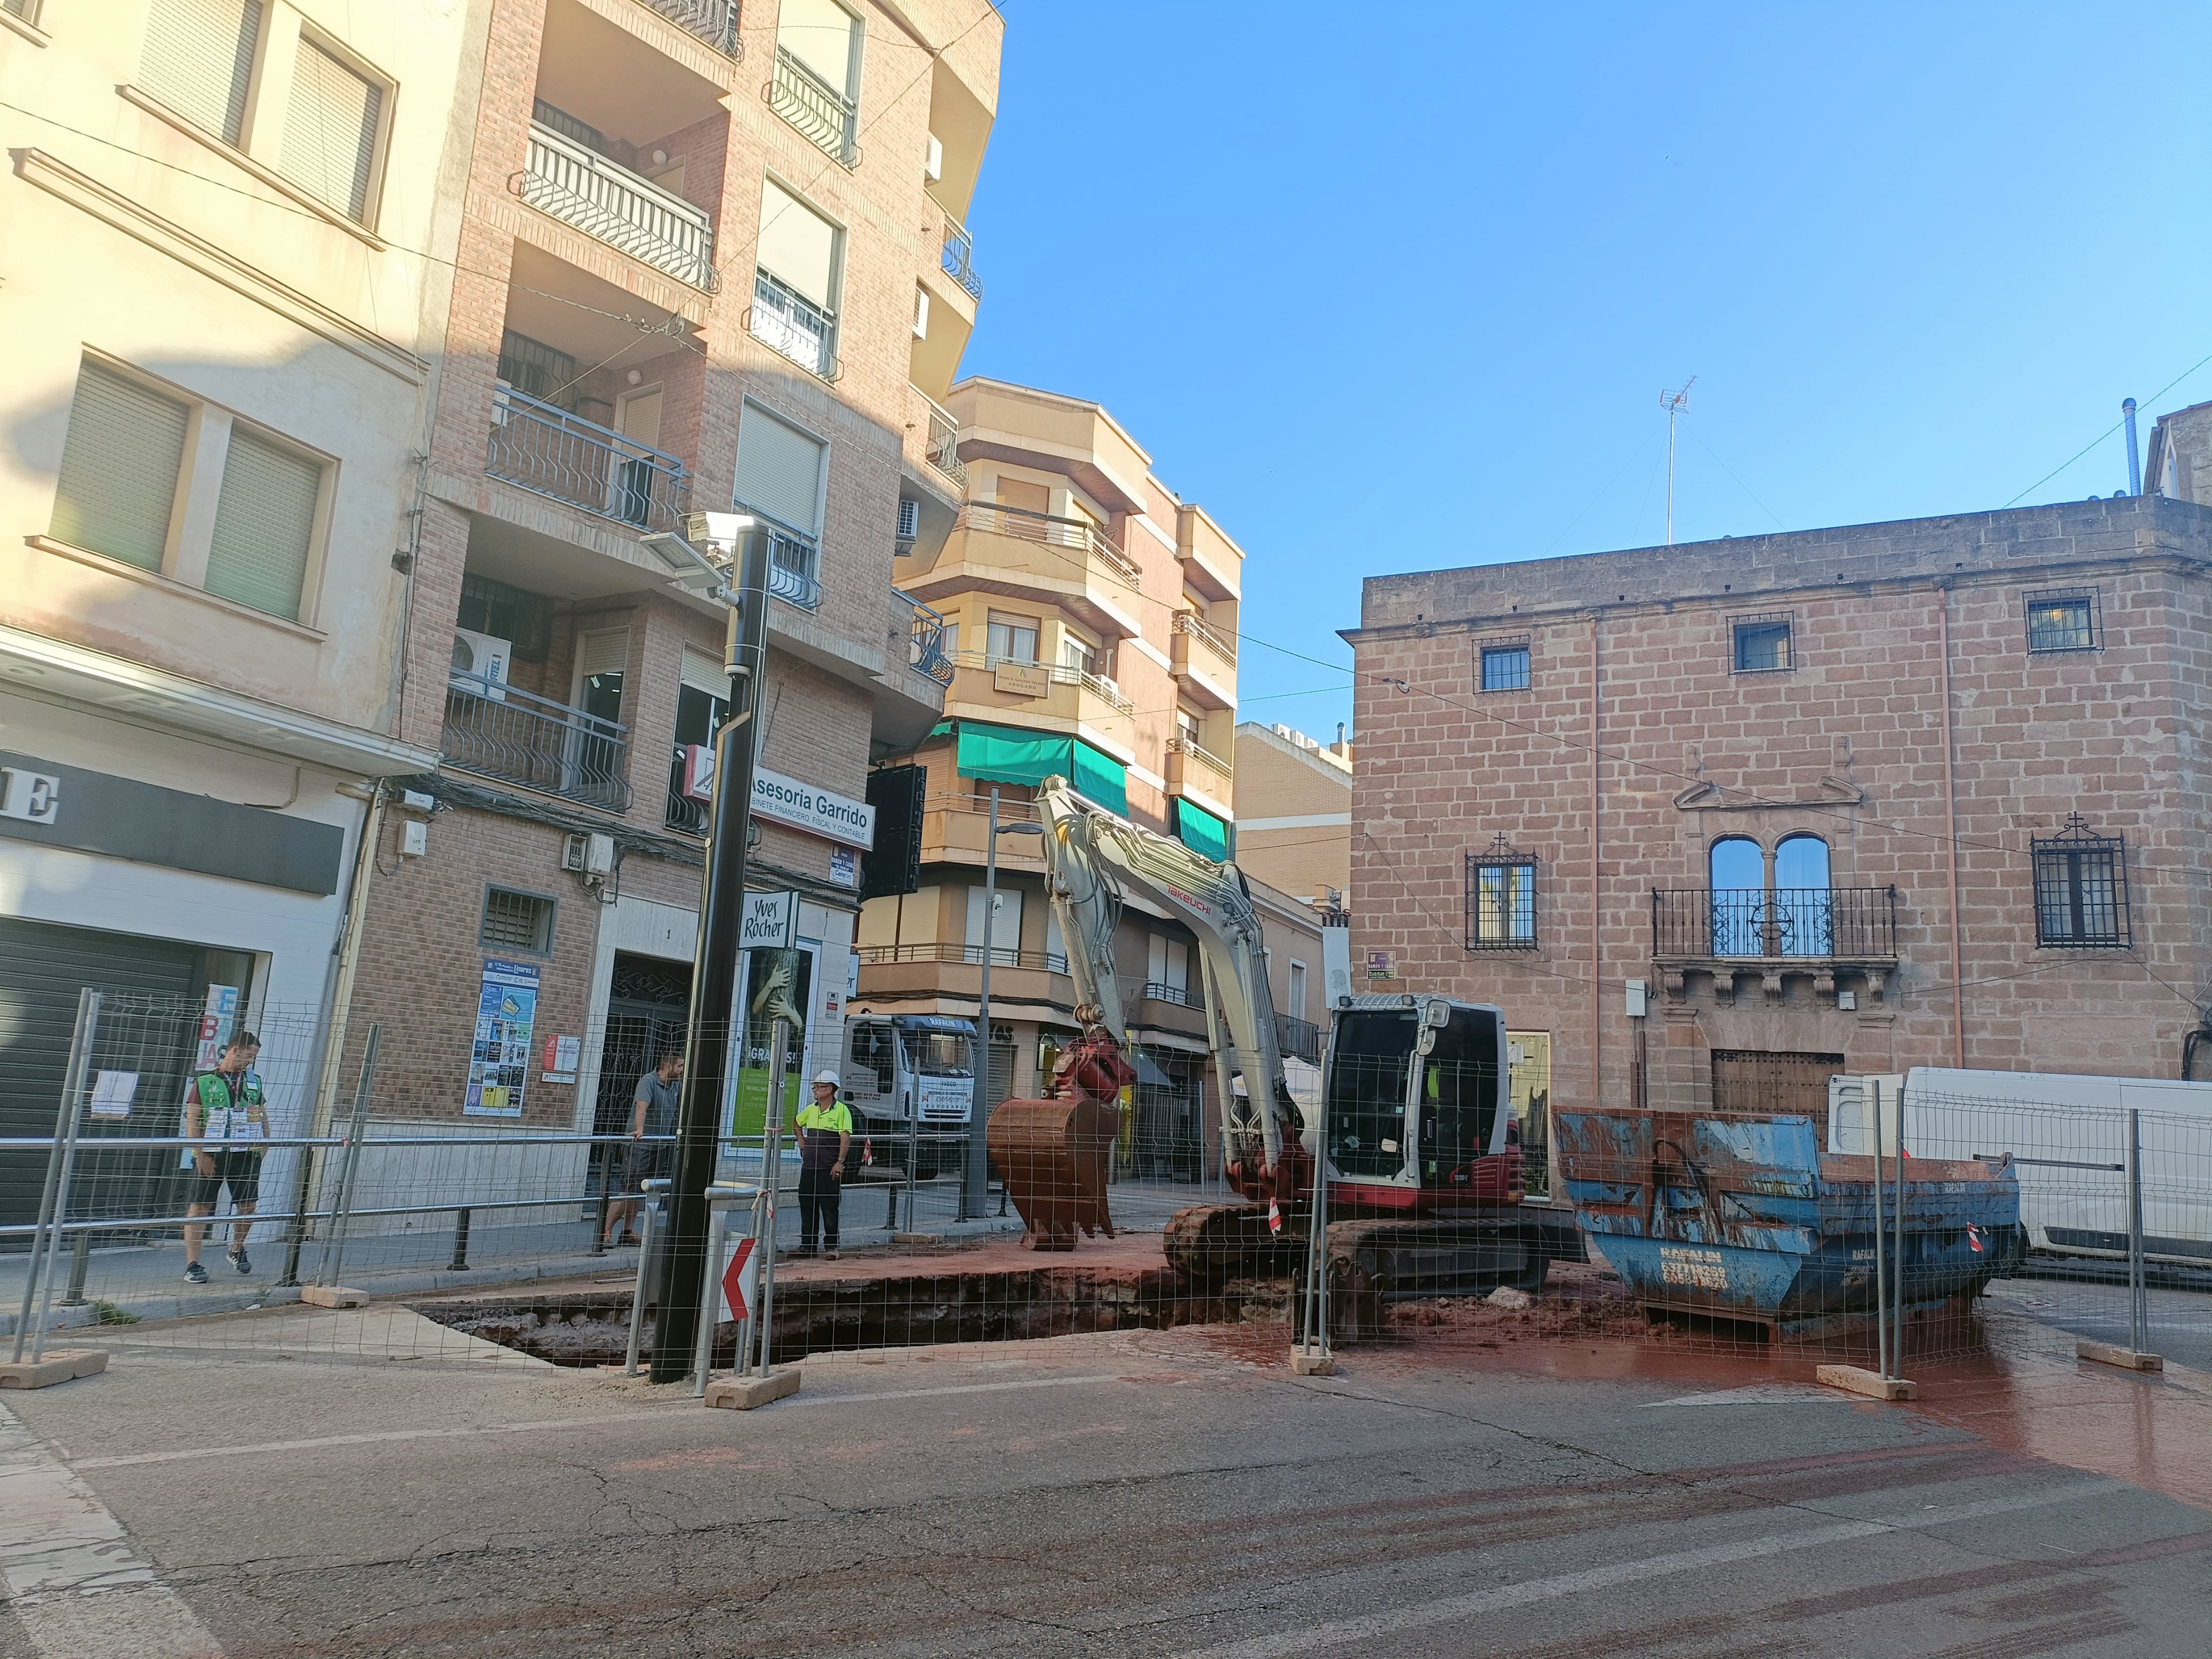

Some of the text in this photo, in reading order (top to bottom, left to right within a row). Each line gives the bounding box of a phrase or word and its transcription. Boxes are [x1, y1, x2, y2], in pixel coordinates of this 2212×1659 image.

[816, 795, 867, 827] Garrido
[774, 805, 810, 823] FINANCIERO,
[812, 816, 831, 829] FISCAL
[838, 825, 866, 840] CONTABLE
[755, 899, 778, 922] Yves
[667, 929, 670, 939] 1
[744, 918, 784, 939] Rocher
[514, 964, 532, 974] Linares
[929, 1018, 956, 1028] RAFALIN
